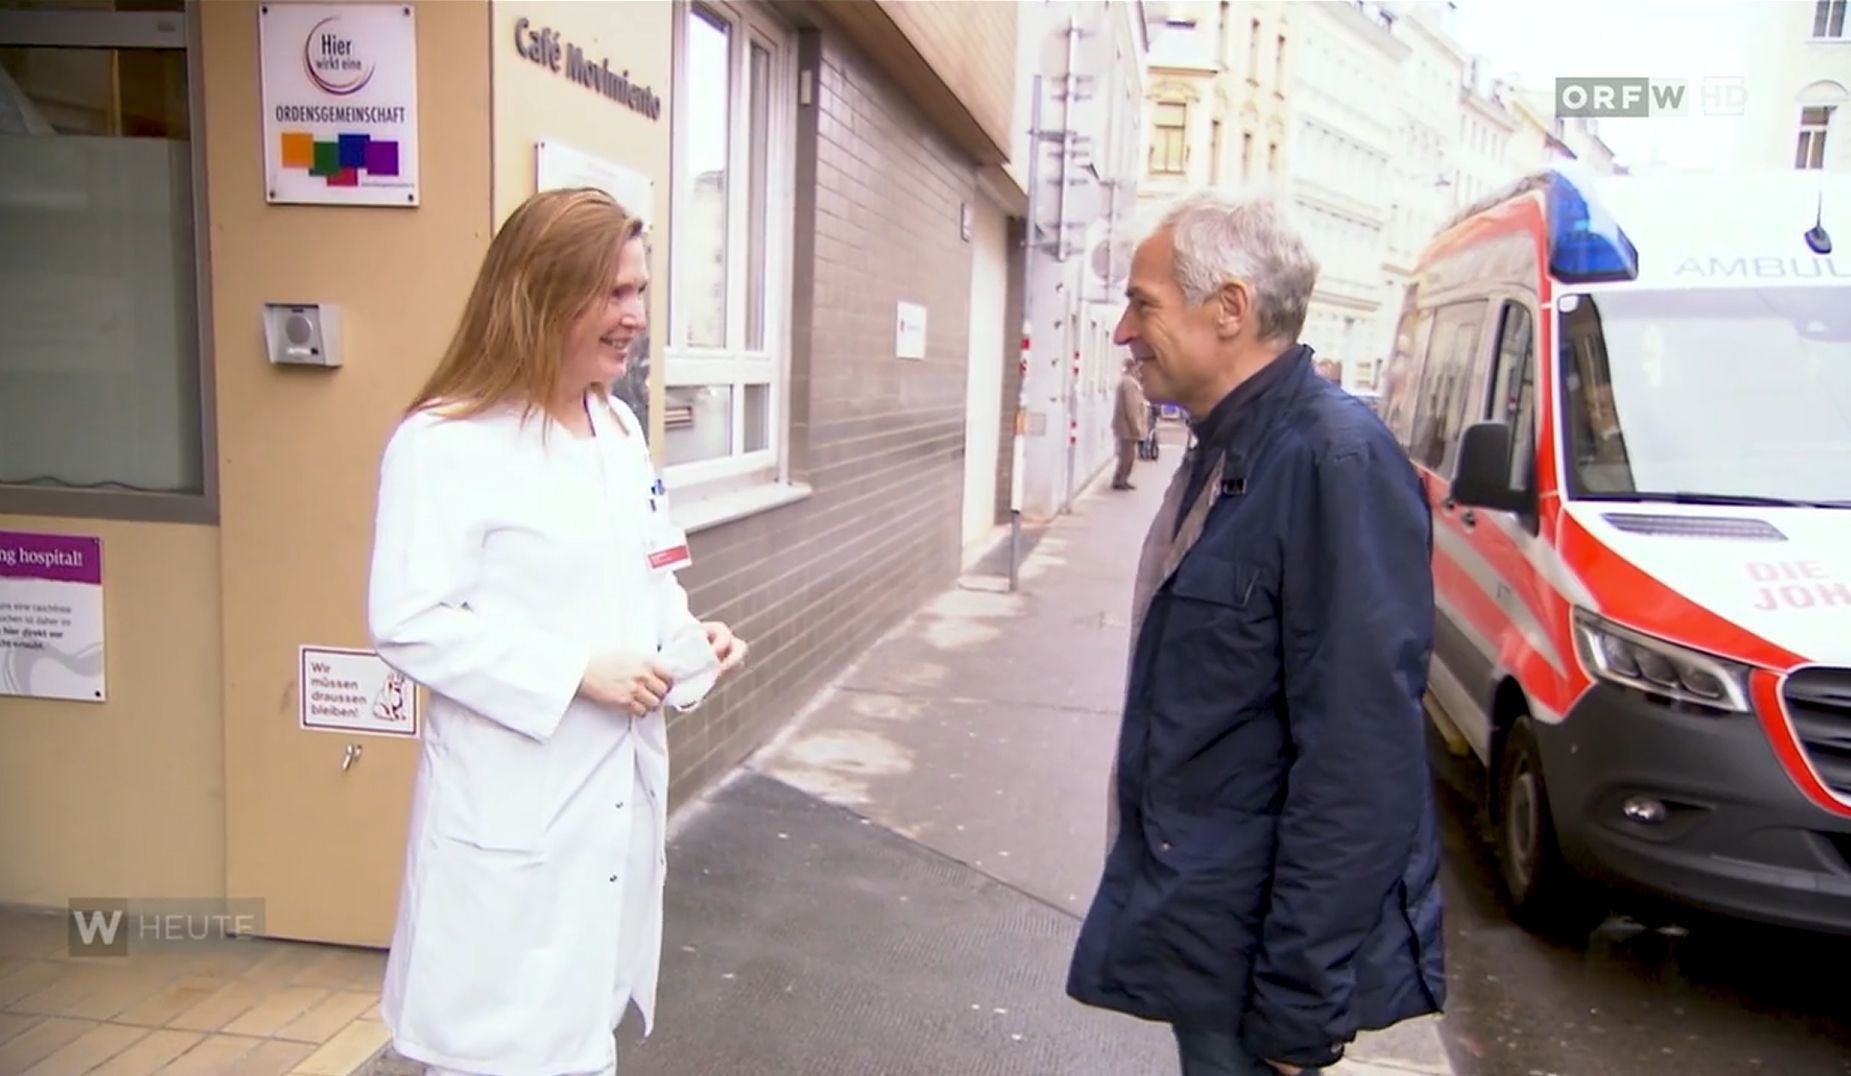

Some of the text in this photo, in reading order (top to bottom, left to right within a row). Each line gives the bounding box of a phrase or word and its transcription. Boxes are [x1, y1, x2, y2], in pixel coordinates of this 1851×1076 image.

[321, 33, 352, 56] Hier
[316, 56, 362, 71] wirkt eine
[514, 17, 661, 122] Café Movimiento
[275, 105, 406, 124] ORDENSGEMEINSCHAFT
[19, 546, 83, 568] hospital!
[1744, 560, 1831, 582] DIE
[1753, 583, 1851, 611] JOH
[311, 661, 331, 674] Wir
[311, 677, 359, 690] müssen
[311, 691, 367, 704] draussen
[311, 703, 359, 718] bleiben!
